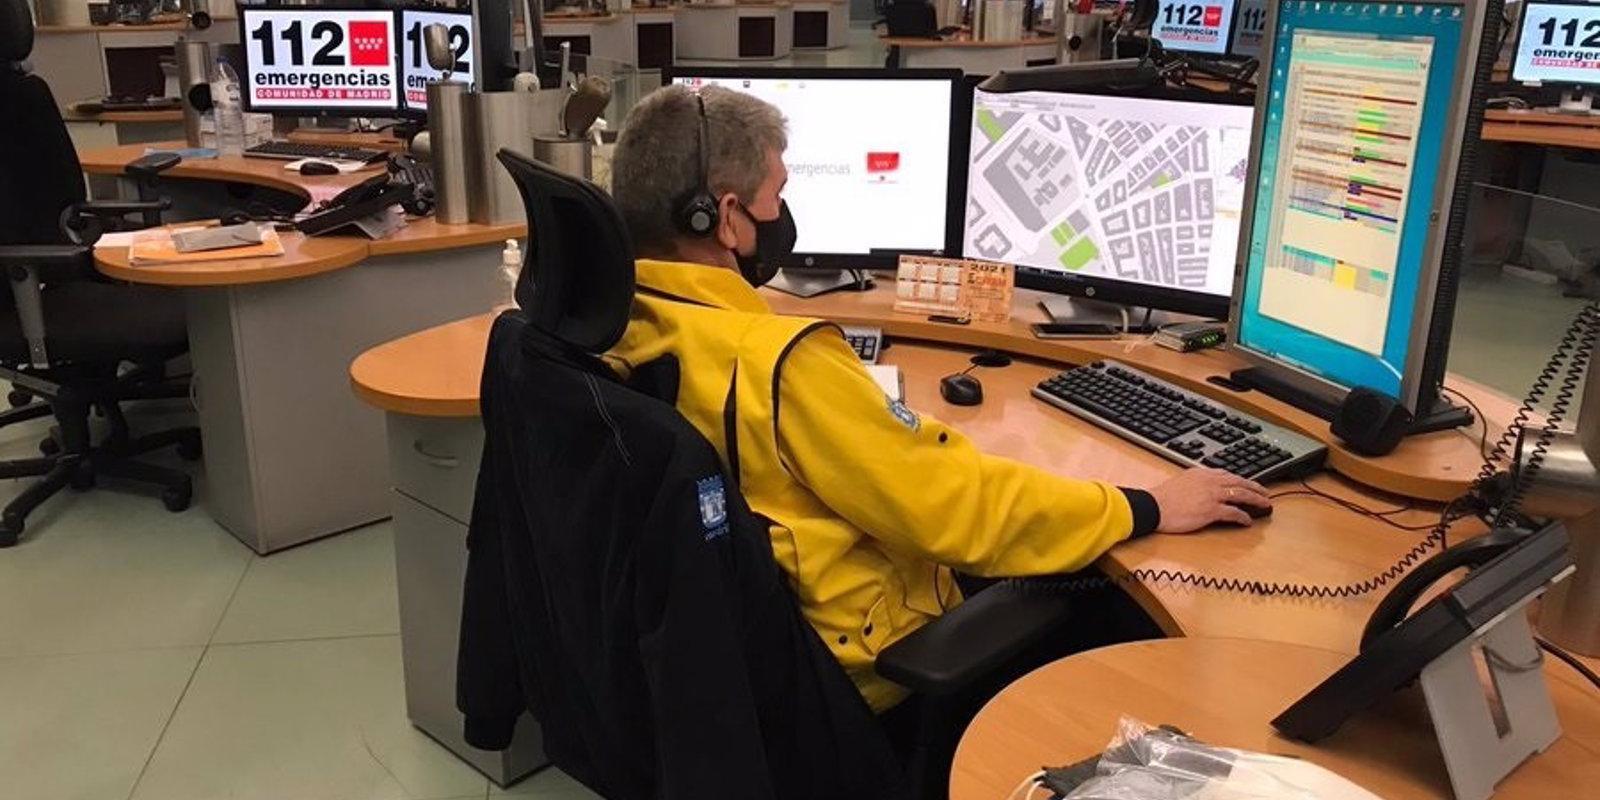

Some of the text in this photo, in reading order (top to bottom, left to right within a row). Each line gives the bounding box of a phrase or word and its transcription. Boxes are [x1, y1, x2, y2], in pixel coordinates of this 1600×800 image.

[1164, 3, 1203, 26] 112
[252, 20, 345, 66] 112
[1539, 16, 1600, 48] 112
[406, 21, 470, 73] 12
[255, 69, 390, 89] emergencias
[257, 88, 390, 99] COMUNIDAD DE MADRID
